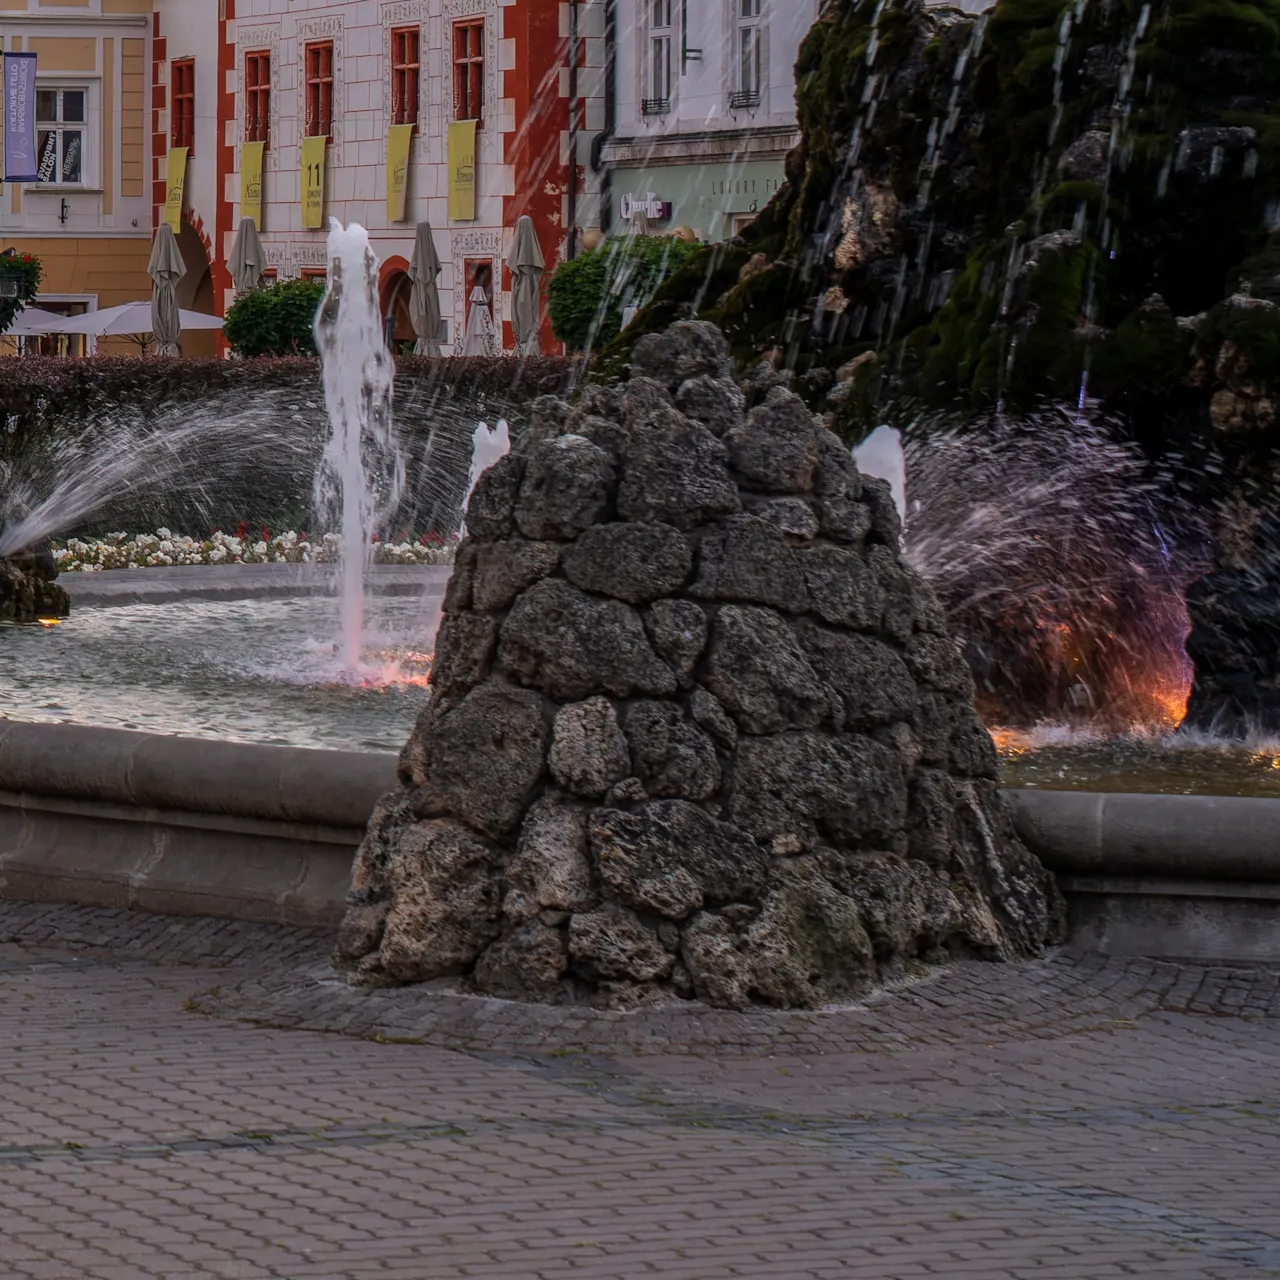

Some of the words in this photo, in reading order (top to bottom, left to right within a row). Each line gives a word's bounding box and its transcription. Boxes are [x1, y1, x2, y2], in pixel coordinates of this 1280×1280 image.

[37, 131, 56, 180] SVADOBNÝ
[42, 153, 56, 182] SALON
[307, 163, 320, 187] 11
[712, 180, 755, 195] LUXURY
